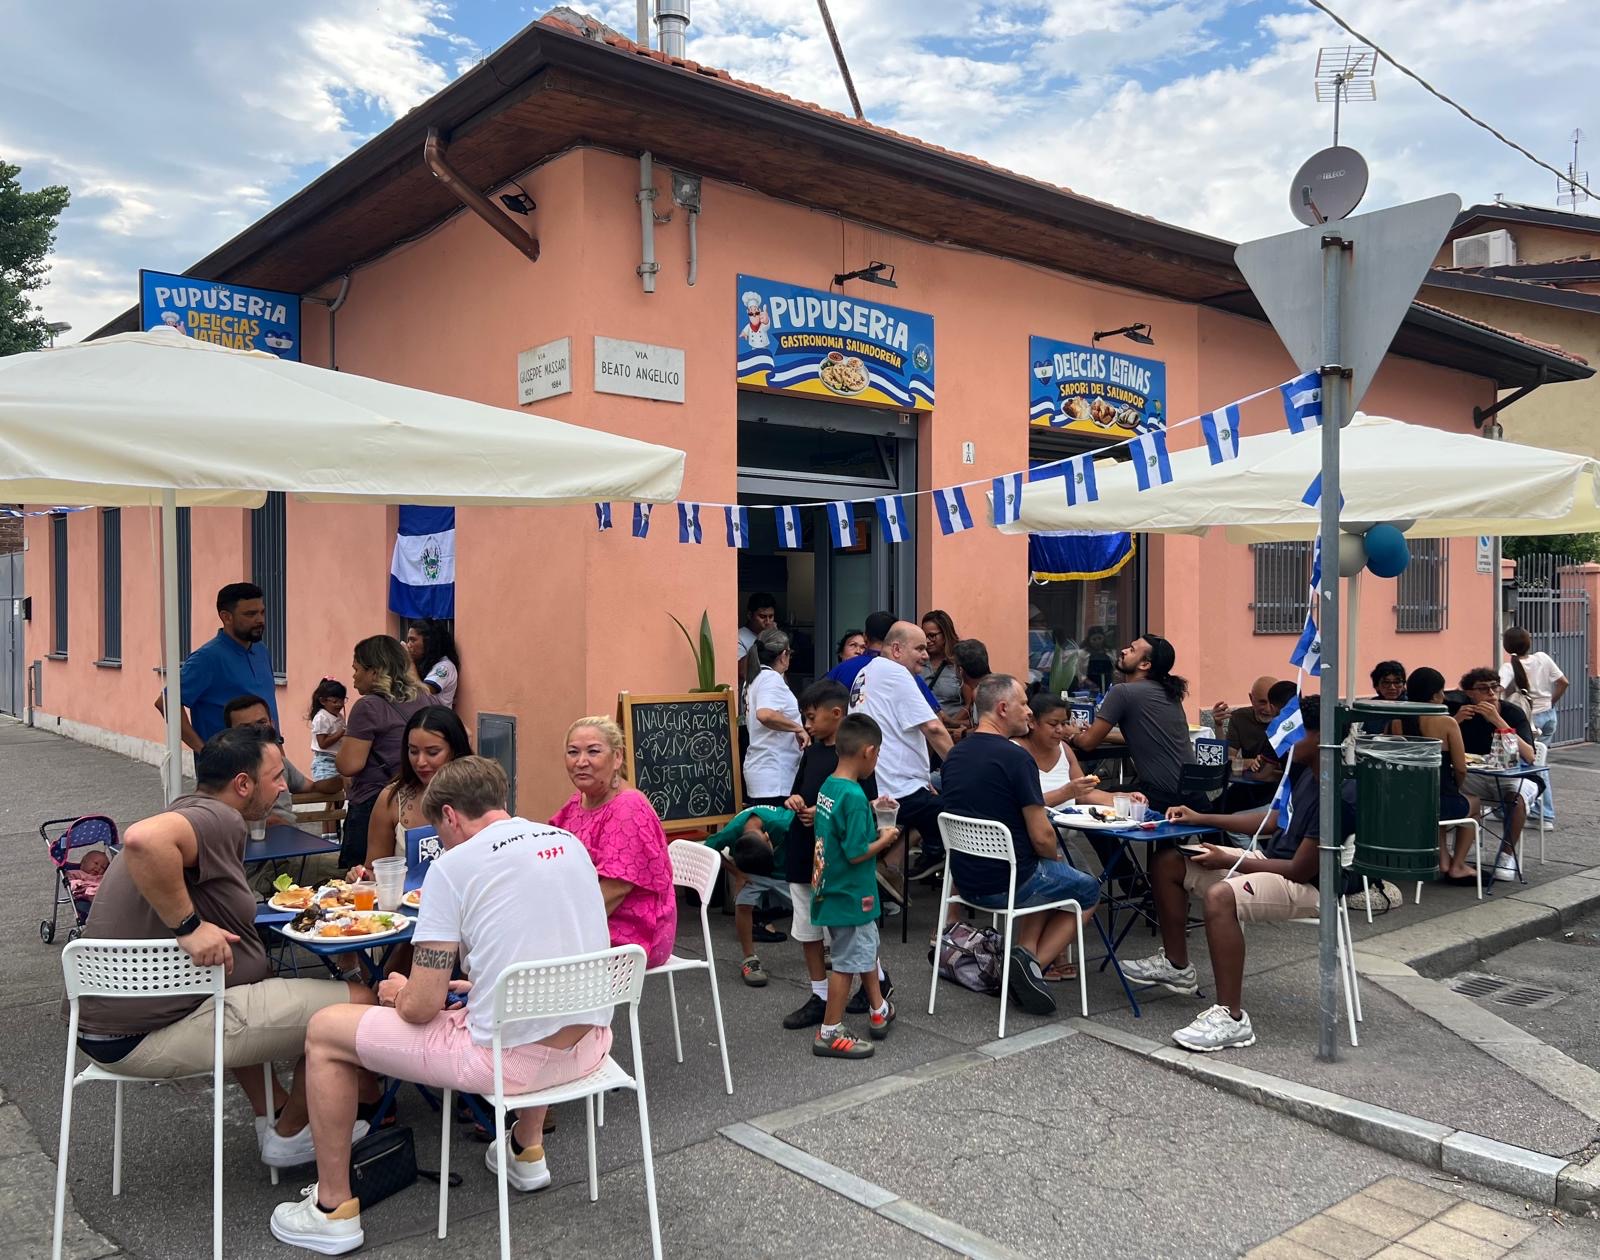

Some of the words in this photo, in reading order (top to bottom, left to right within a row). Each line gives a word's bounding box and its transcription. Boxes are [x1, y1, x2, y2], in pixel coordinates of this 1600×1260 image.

[635, 351, 648, 360] VIA
[846, 339, 901, 368] SALVADOREÑA
[520, 365, 542, 383] GIUSEPPE
[545, 358, 566, 375] MASSARI
[601, 361, 631, 378] BEATO
[636, 367, 679, 386] ANGELICO
[1091, 383, 1105, 396] DEL
[1107, 385, 1145, 409] SALVADOR
[966, 454, 972, 463] A
[638, 761, 727, 788] ASPETTIAMO
[492, 834, 525, 852] SAINT
[537, 845, 564, 860] 1971
